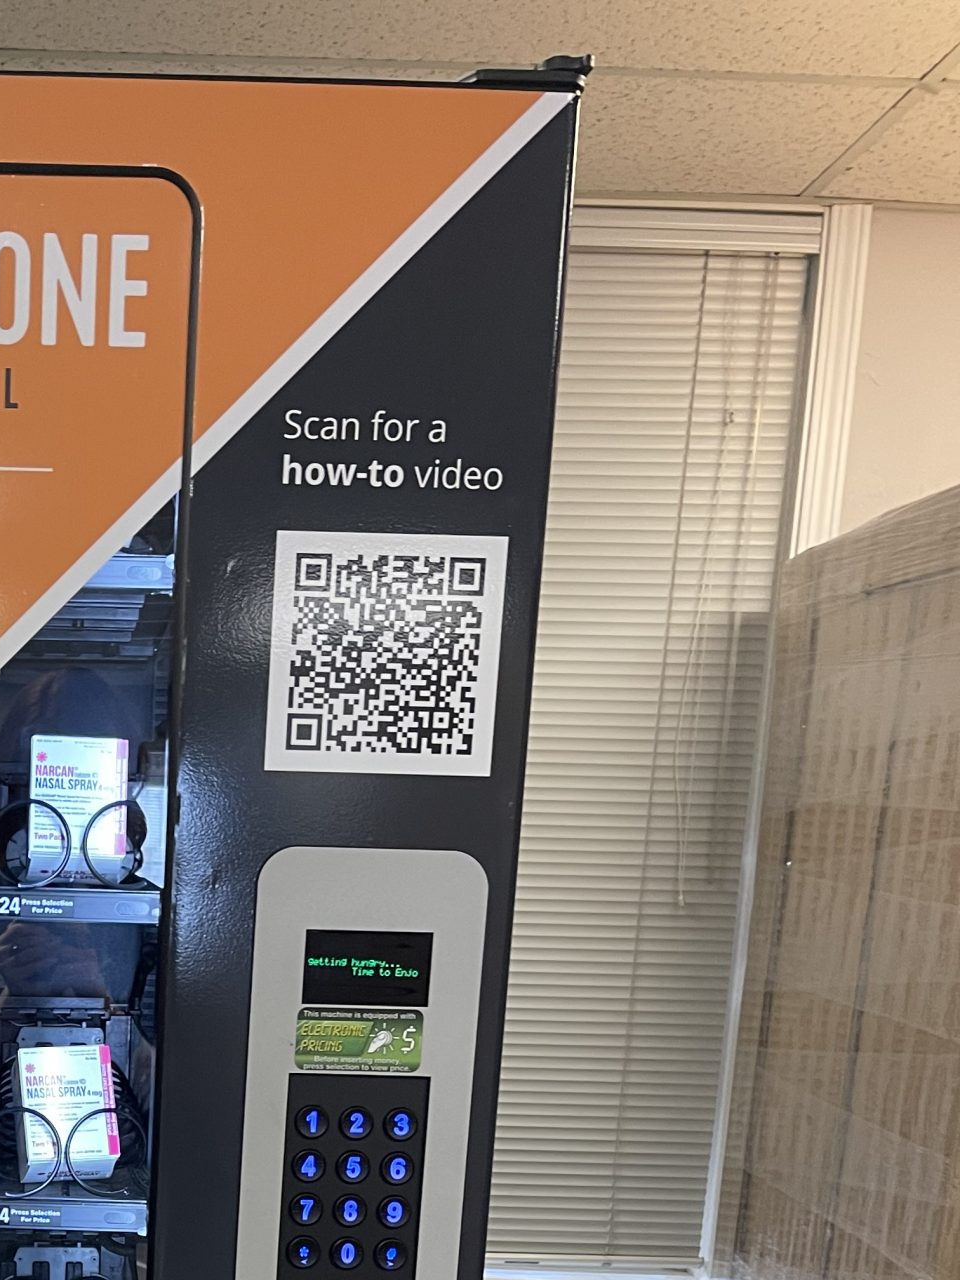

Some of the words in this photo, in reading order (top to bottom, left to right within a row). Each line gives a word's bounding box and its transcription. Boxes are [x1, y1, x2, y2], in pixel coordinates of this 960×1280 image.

[283, 409, 360, 442] Scan
[371, 410, 419, 442] for
[428, 418, 447, 443] a
[281, 453, 404, 488] how-to
[414, 459, 503, 490] video
[35, 764, 74, 778] NARCAN
[35, 777, 66, 790] NASAL
[68, 778, 99, 791] SPRAY
[0, 896, 20, 914] 24
[352, 967, 375, 976] Time
[379, 968, 390, 977] to
[395, 968, 419, 978] Enjo
[303, 1010, 319, 1018] This
[321, 1010, 352, 1019] machine
[362, 1011, 399, 1020] equipped
[400, 1012, 417, 1020] with
[300, 1024, 367, 1037] ELECTRONIC
[300, 1039, 342, 1052] PRICING
[303, 1063, 324, 1071] press
[326, 1063, 360, 1071] selection
[314, 1055, 339, 1063] Before
[340, 1056, 373, 1065] inserting
[25, 1075, 63, 1087] NARCAN
[26, 1086, 56, 1100] NASAL
[58, 1086, 87, 1098] SPRAY
[306, 1110, 318, 1133] 1
[349, 1113, 364, 1133] 2
[393, 1113, 410, 1136] 3
[301, 1155, 316, 1177] 4
[346, 1156, 361, 1179] 5
[390, 1157, 406, 1180] 6
[300, 1199, 314, 1221] 7
[343, 1200, 358, 1222] 8
[386, 1201, 402, 1223] 9
[340, 1242, 355, 1264] 0
